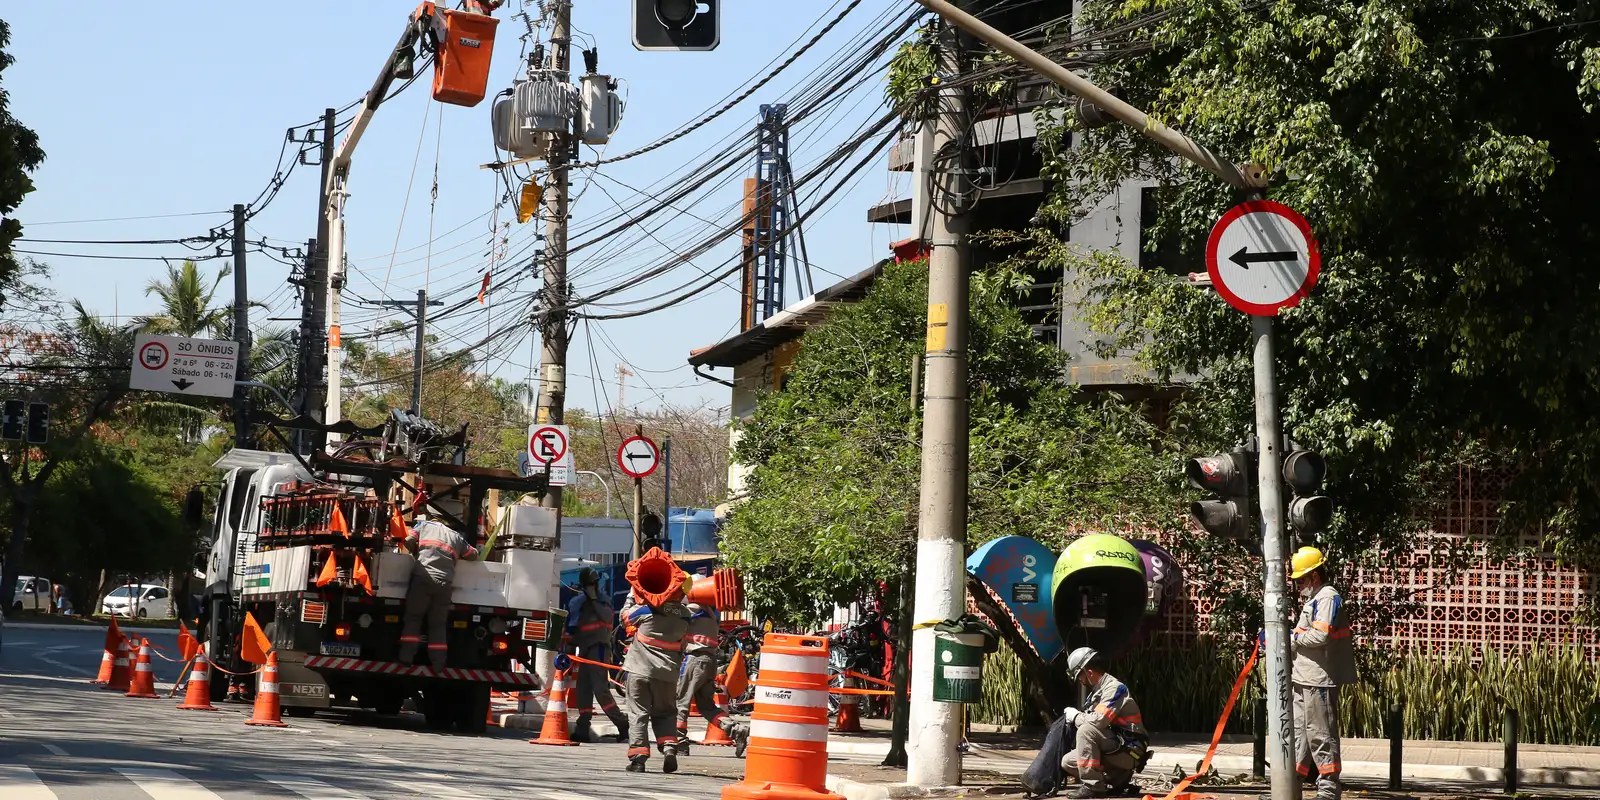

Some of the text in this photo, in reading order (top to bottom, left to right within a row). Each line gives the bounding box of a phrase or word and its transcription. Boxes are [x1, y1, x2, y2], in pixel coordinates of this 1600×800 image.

[178, 341, 234, 355] SÓ ÔNIBUS
[204, 360, 214, 368] 06
[220, 362, 234, 370] 22h
[172, 367, 200, 377] Sábado
[204, 370, 213, 378] 06
[541, 434, 556, 456] E
[292, 684, 324, 694] NEXT
[765, 690, 792, 700] Manserv
